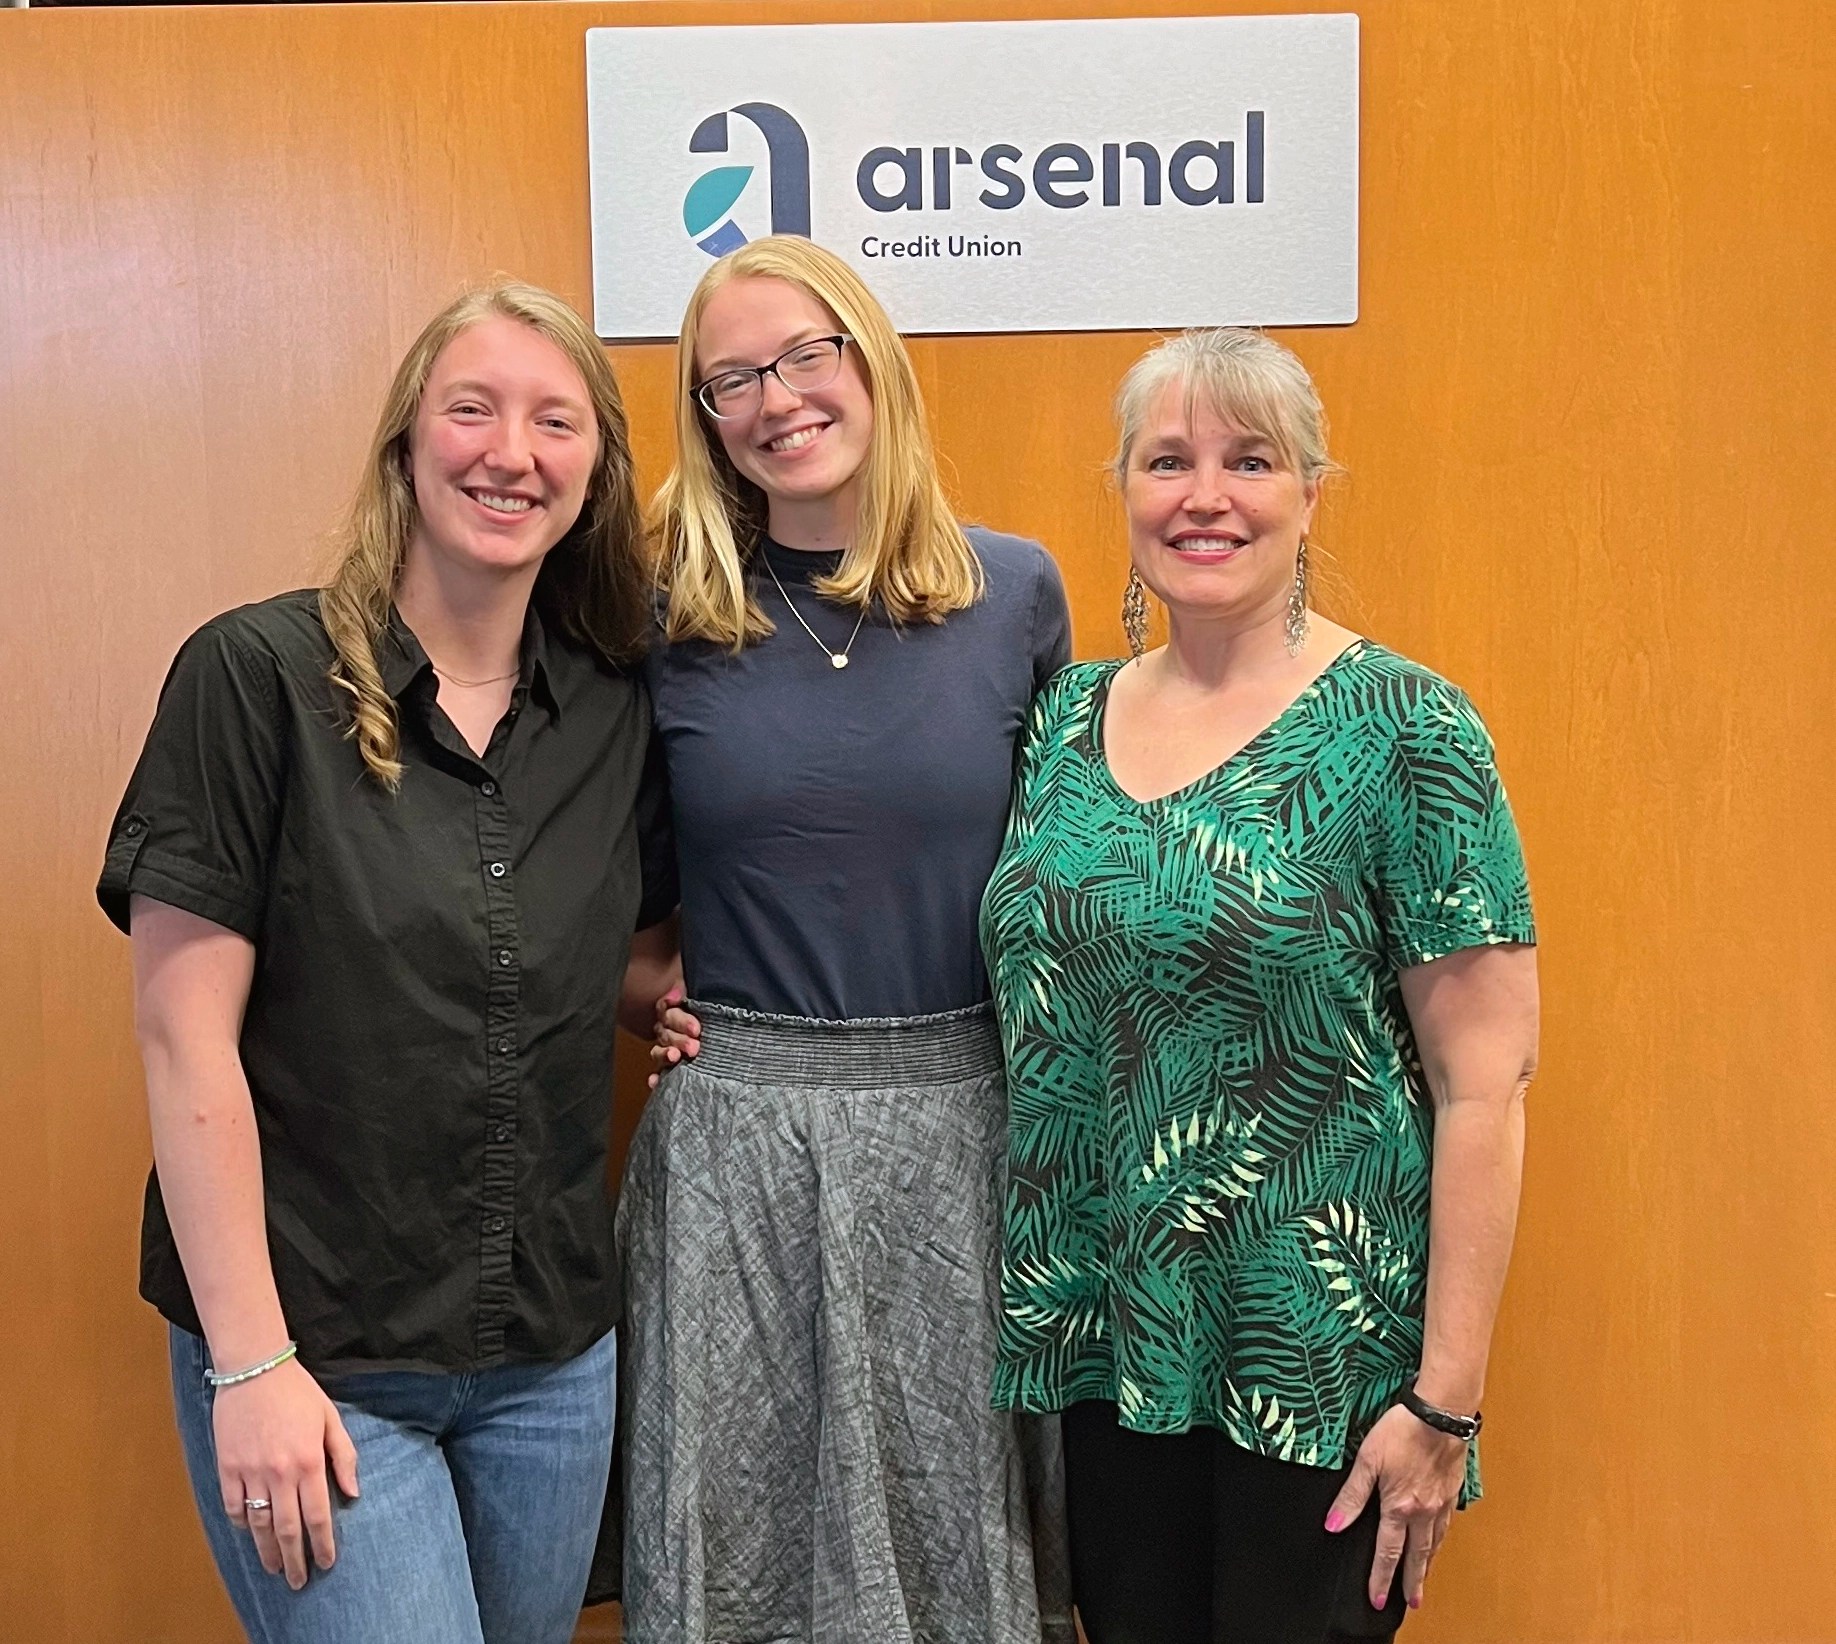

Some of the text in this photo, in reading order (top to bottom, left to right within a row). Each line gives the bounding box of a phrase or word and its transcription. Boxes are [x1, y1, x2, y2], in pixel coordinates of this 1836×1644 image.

[857, 111, 1265, 213] arsenal
[861, 234, 1022, 258] Credit Union
